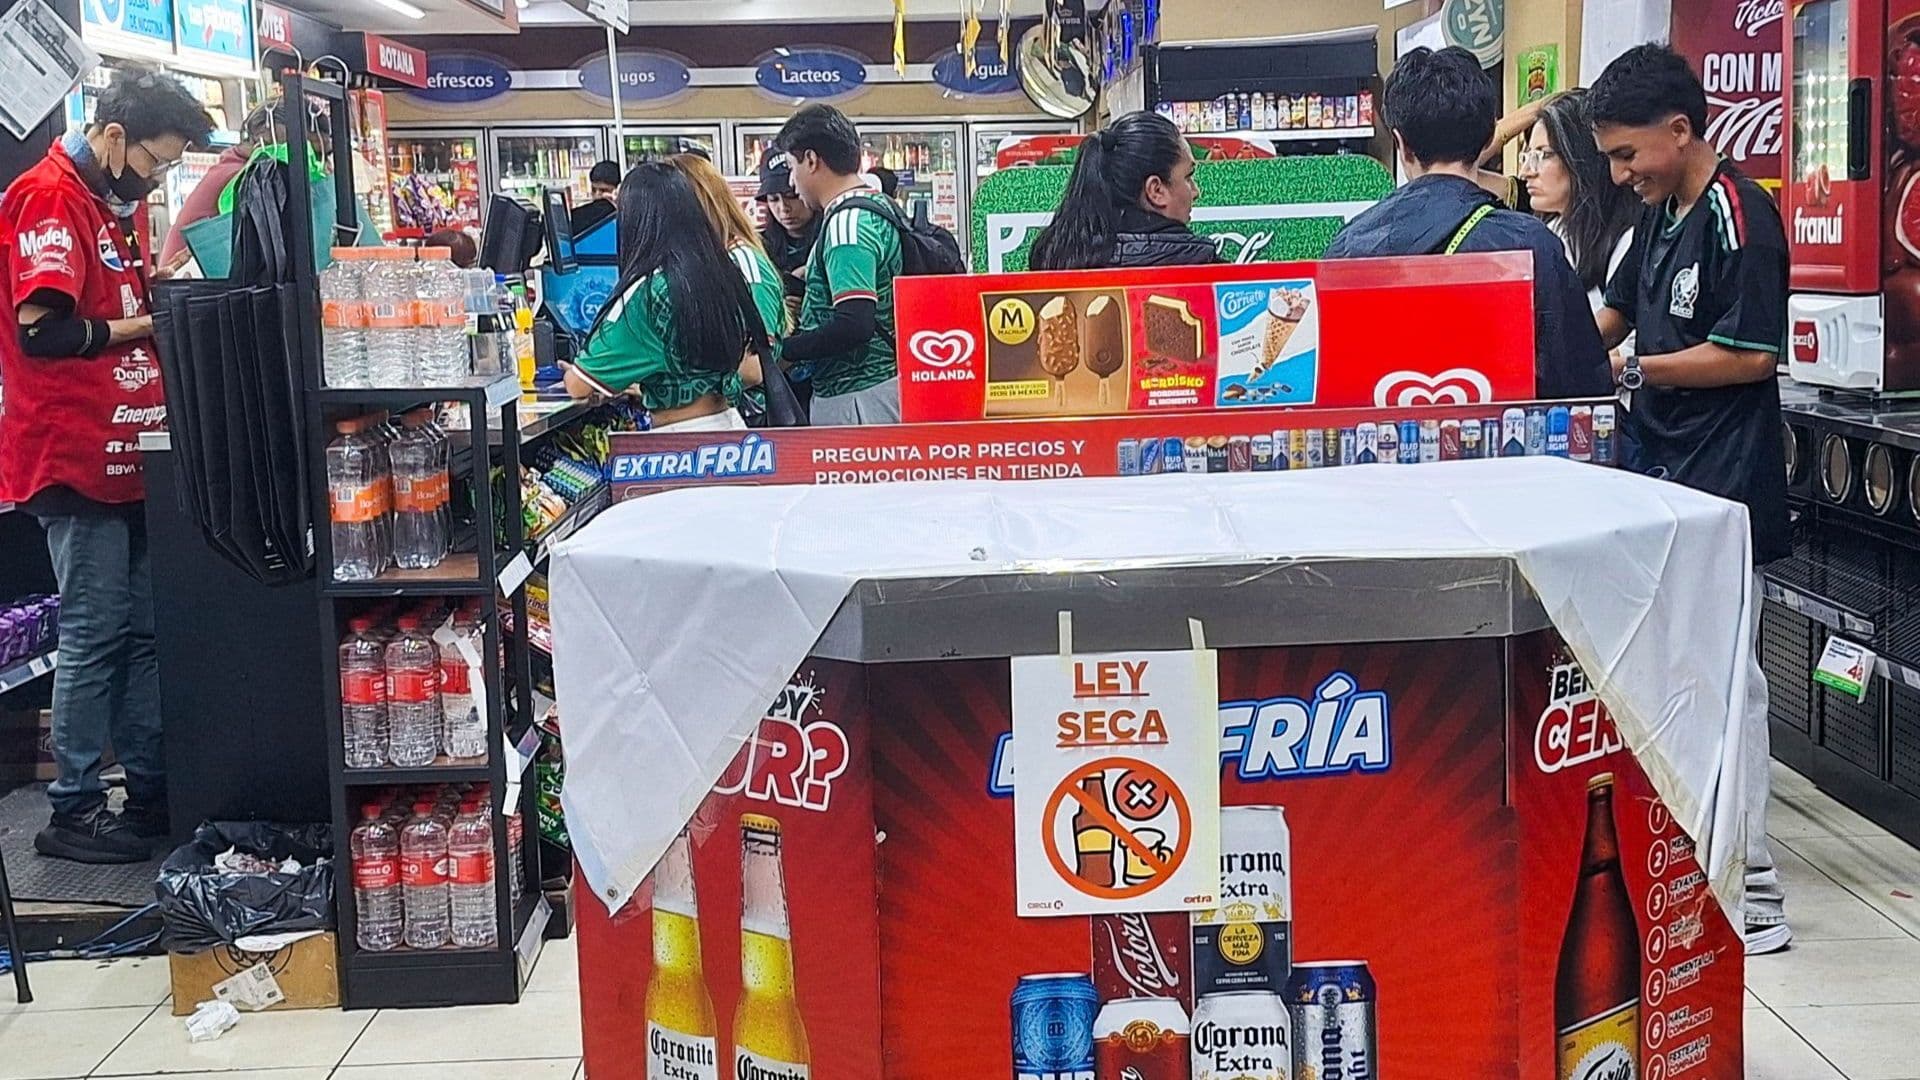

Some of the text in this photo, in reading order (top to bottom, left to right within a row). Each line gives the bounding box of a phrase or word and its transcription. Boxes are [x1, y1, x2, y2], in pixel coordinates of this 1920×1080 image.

[379, 43, 415, 77] BOTANA
[426, 71, 494, 89] efrescos
[620, 69, 656, 87] ugos
[781, 67, 841, 84] Lacteos
[1703, 52, 1754, 93] CON
[1794, 204, 1844, 245] franui
[18, 226, 73, 257] Modelo
[911, 369, 976, 383] HOLANDA
[811, 440, 1086, 463] PREGUNTA POR PRECIOS Y
[106, 463, 136, 476] BBVA
[815, 462, 1083, 485] PROMOCIONES EN TIENDA
[1073, 661, 1149, 694] LEY
[1056, 709, 1169, 743] SECA
[1183, 894, 1212, 904] extra
[1222, 933, 1260, 943] CERVEZA
[1234, 927, 1247, 935] LA
[1231, 949, 1251, 957] FINA
[650, 1027, 714, 1066] Coronita
[1194, 1021, 1289, 1058] Corona
[1215, 1051, 1273, 1072] Extra
